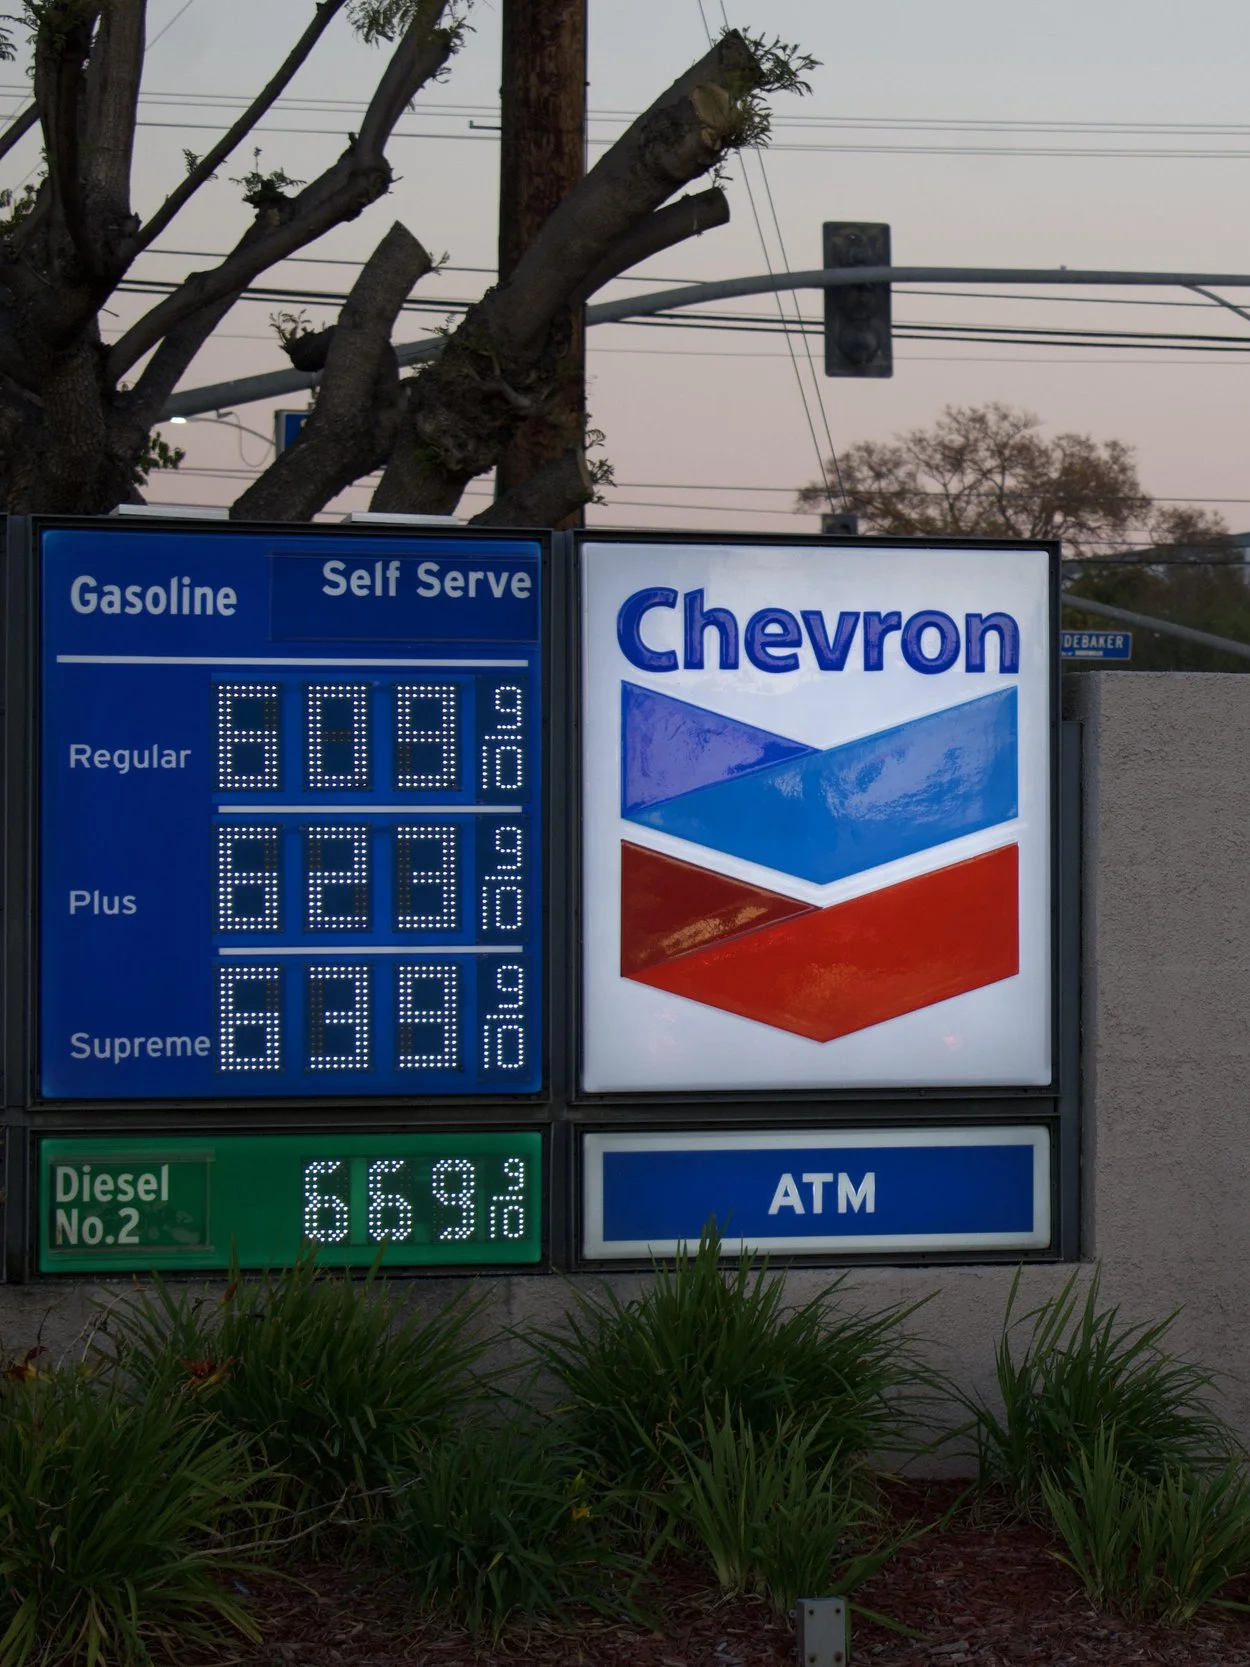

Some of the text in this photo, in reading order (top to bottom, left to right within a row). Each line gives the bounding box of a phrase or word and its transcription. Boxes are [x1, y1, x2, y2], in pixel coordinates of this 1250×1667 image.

[69, 575, 238, 616] Gasoline
[322, 560, 532, 599] Self Serve
[617, 586, 1020, 675] Chevron
[1060, 633, 1125, 649] DEBAKER
[69, 743, 192, 774] Regular
[69, 890, 138, 915] Plus
[70, 1032, 211, 1064] Supreme
[55, 1164, 169, 1203] Diesel
[768, 1172, 877, 1215] ATM
[55, 1207, 141, 1245] No.2
